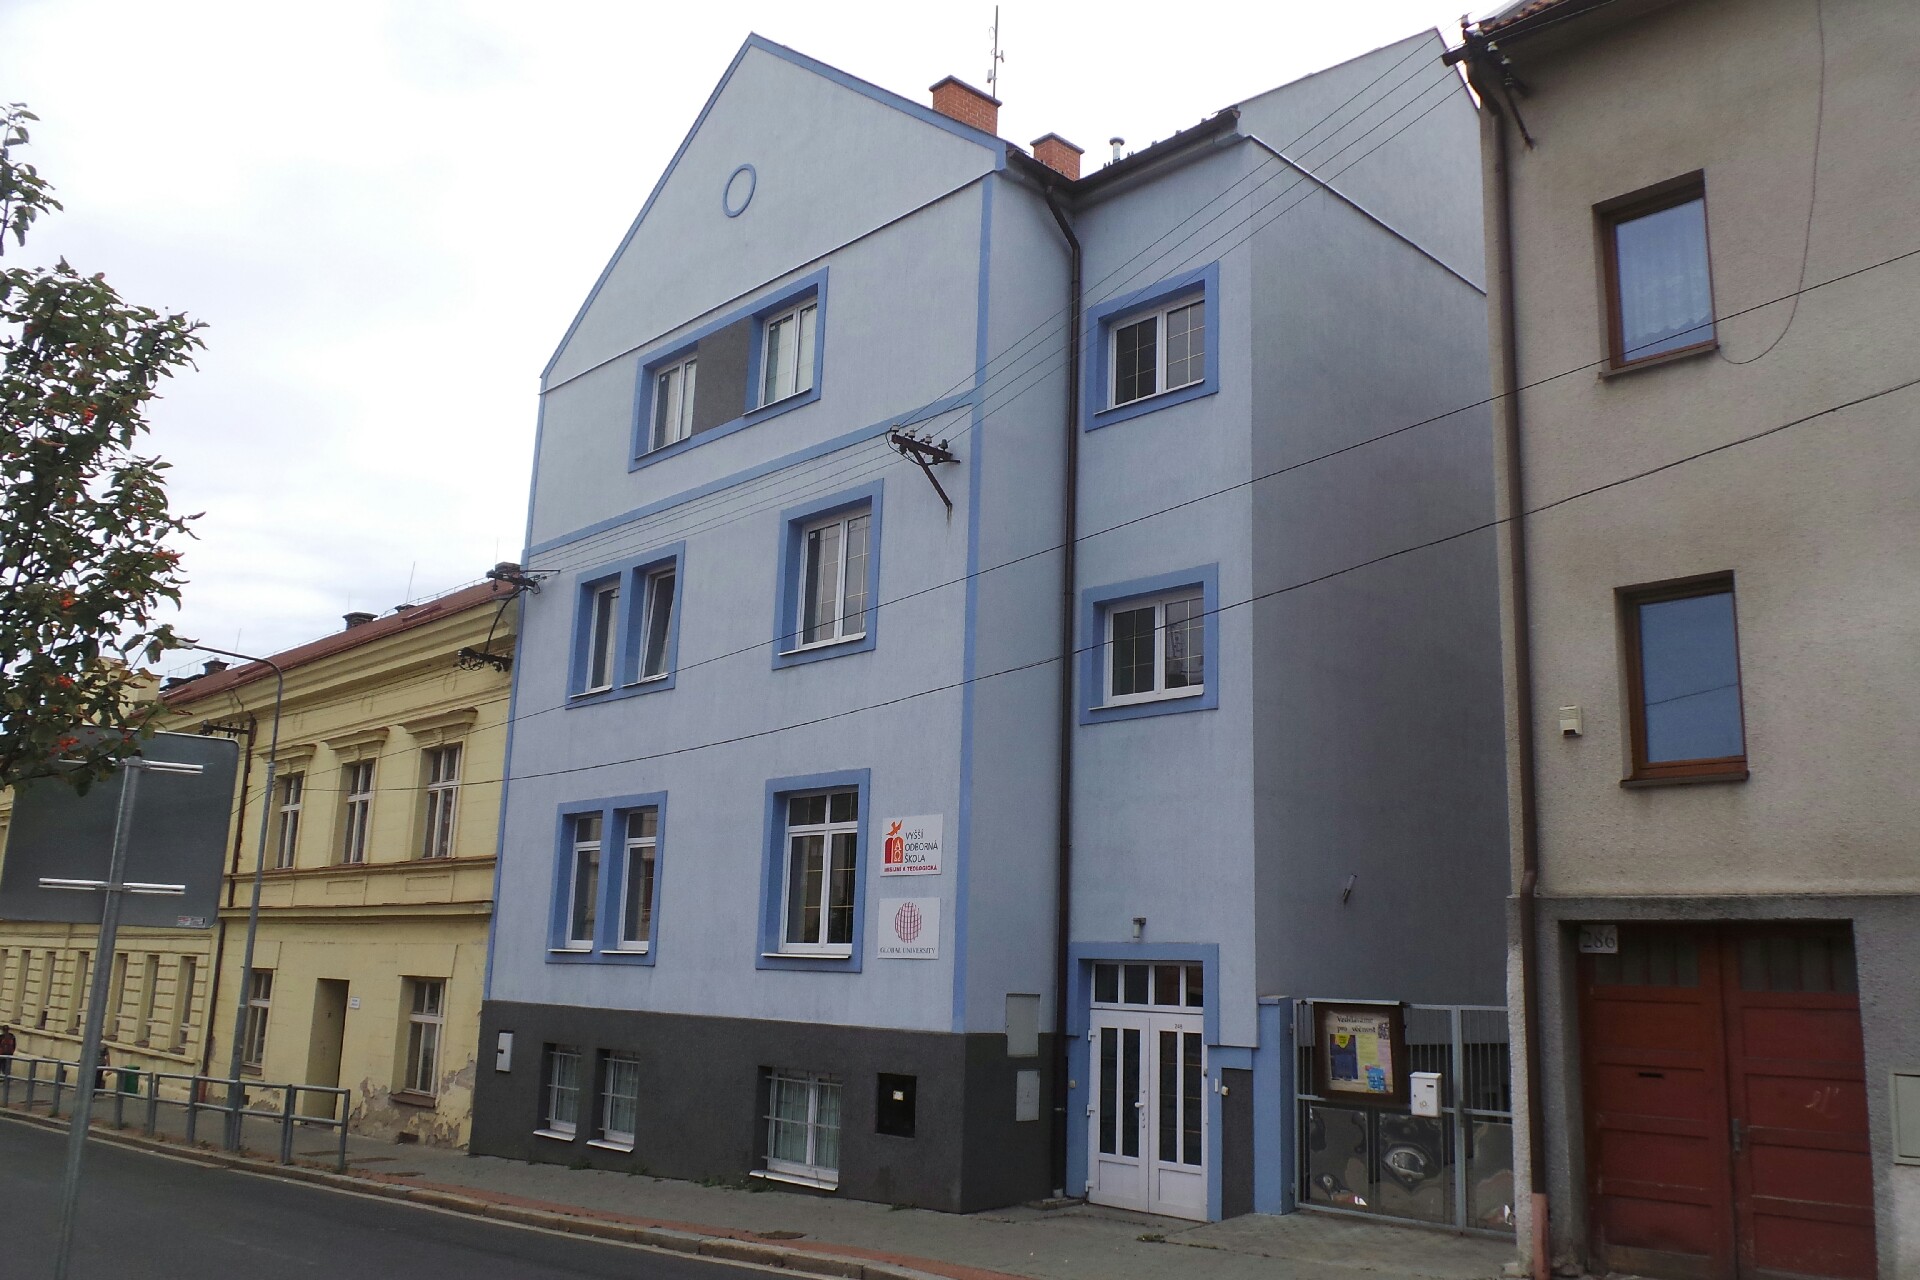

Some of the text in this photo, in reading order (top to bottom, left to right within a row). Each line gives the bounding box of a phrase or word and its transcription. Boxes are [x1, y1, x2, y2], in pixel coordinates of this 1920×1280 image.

[905, 829, 924, 840] VYŠŠÍ
[904, 840, 938, 851] ODBORNÁ
[904, 853, 925, 864] ŠKOLA
[907, 864, 938, 872] TEOLOGICKÁ
[1337, 1025, 1347, 1034] pro
